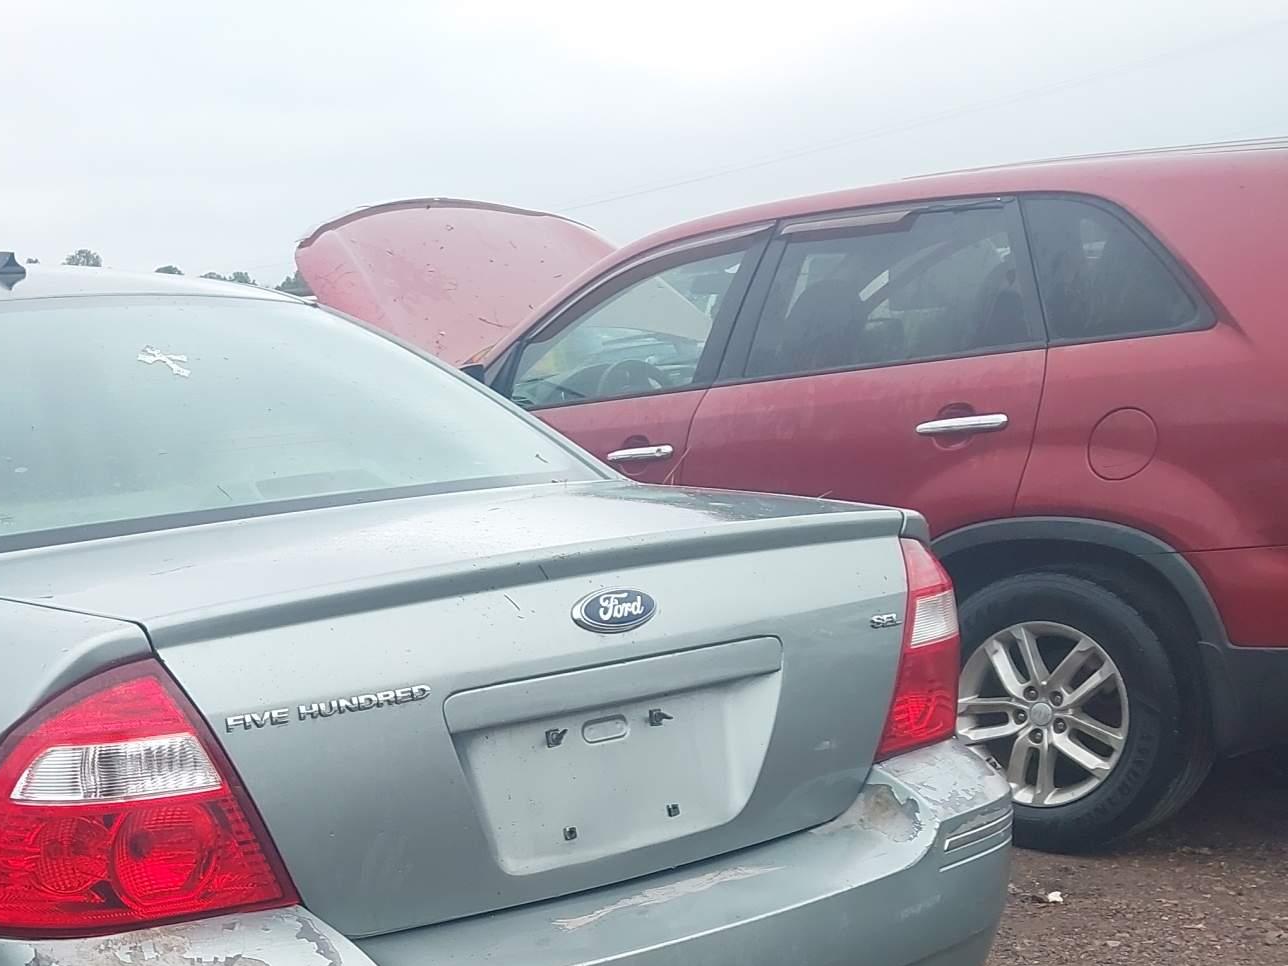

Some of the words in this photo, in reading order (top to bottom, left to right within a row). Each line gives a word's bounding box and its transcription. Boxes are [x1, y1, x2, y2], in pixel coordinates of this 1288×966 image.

[598, 592, 645, 621] Ford
[870, 612, 902, 630] SEL
[225, 708, 289, 733] FIVE
[297, 684, 432, 721] HUNDRED
